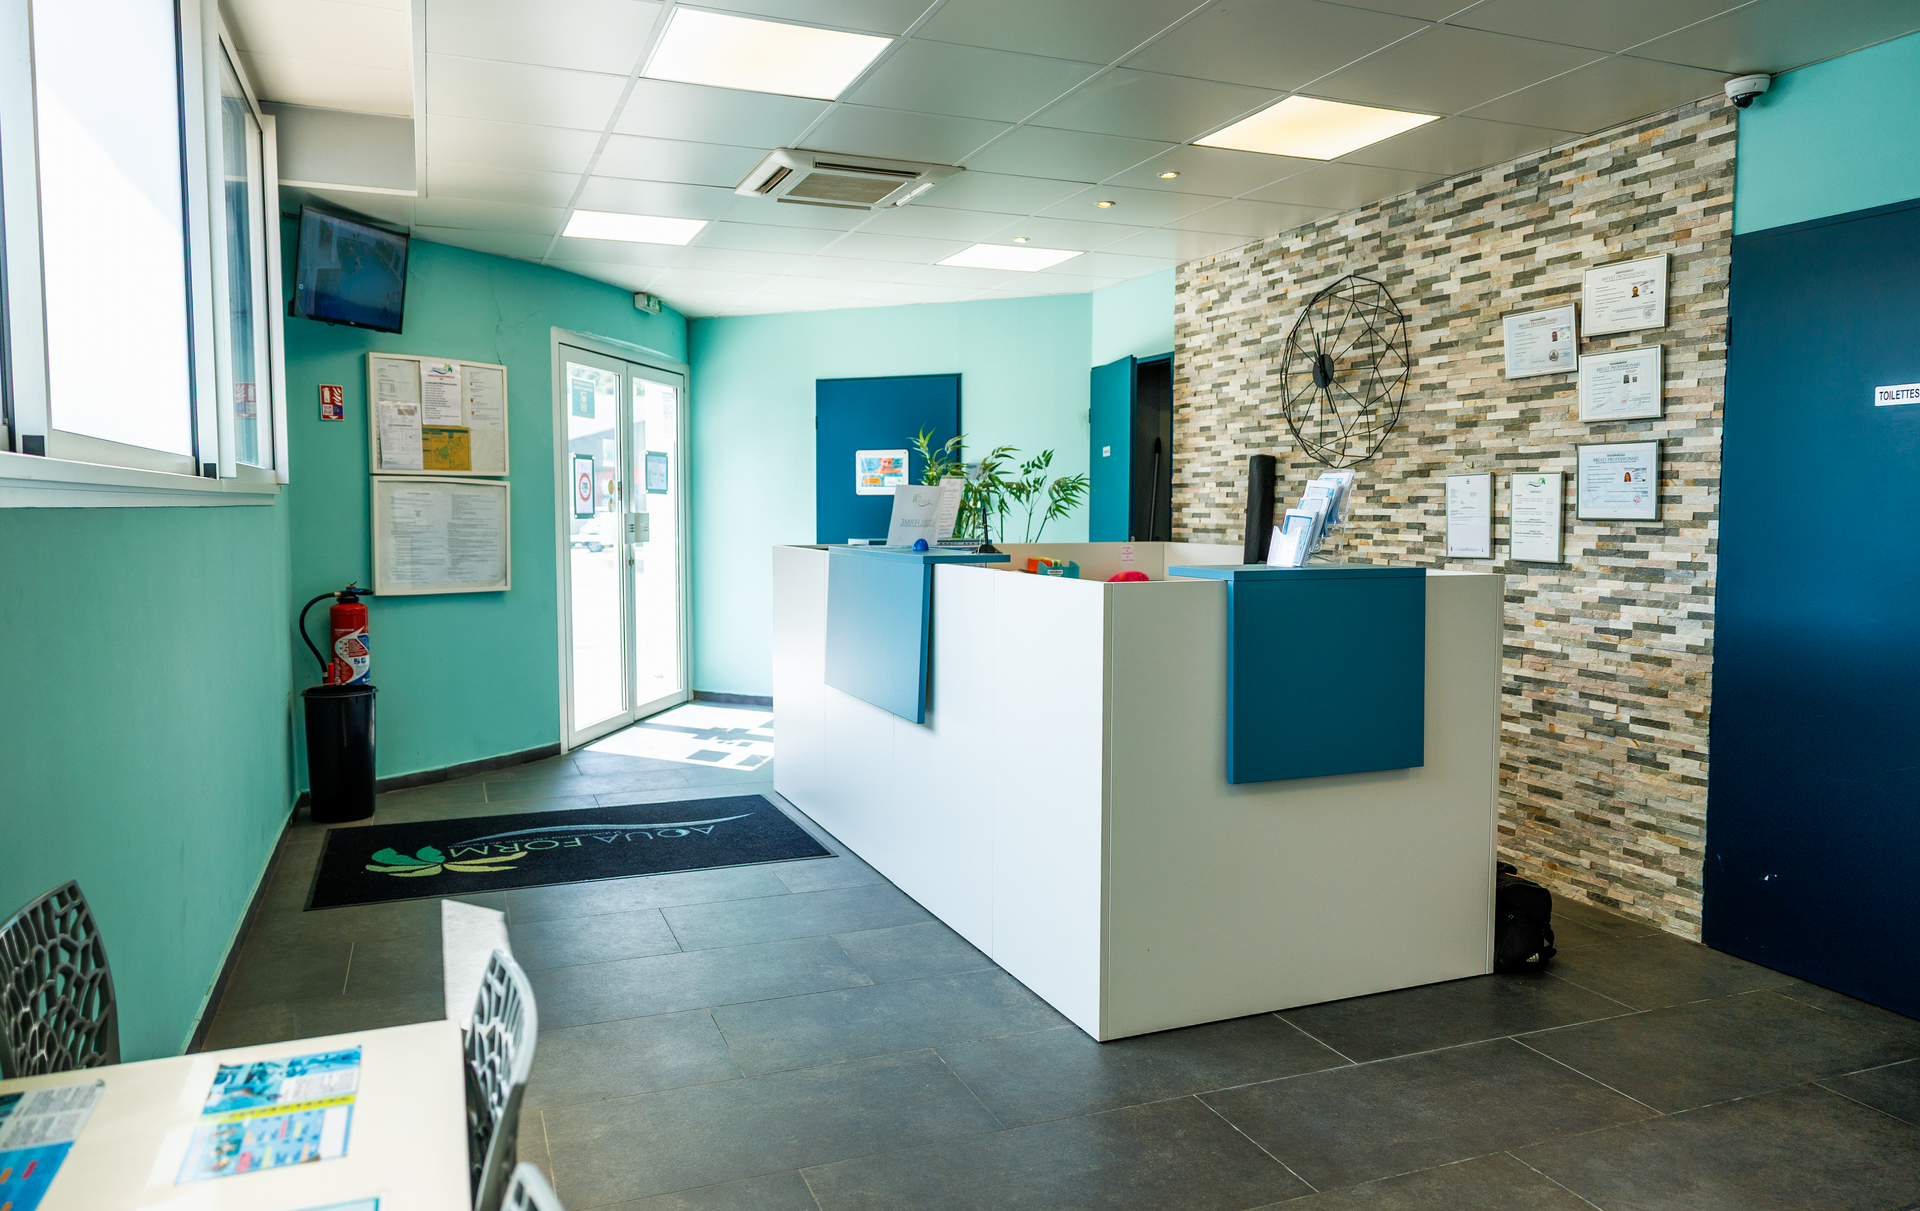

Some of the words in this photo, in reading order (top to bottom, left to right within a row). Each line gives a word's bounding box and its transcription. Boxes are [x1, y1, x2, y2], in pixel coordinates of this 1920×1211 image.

[1879, 388, 1920, 401] TOILETTES
[593, 825, 714, 844] AQUA
[449, 836, 582, 858] FORM
